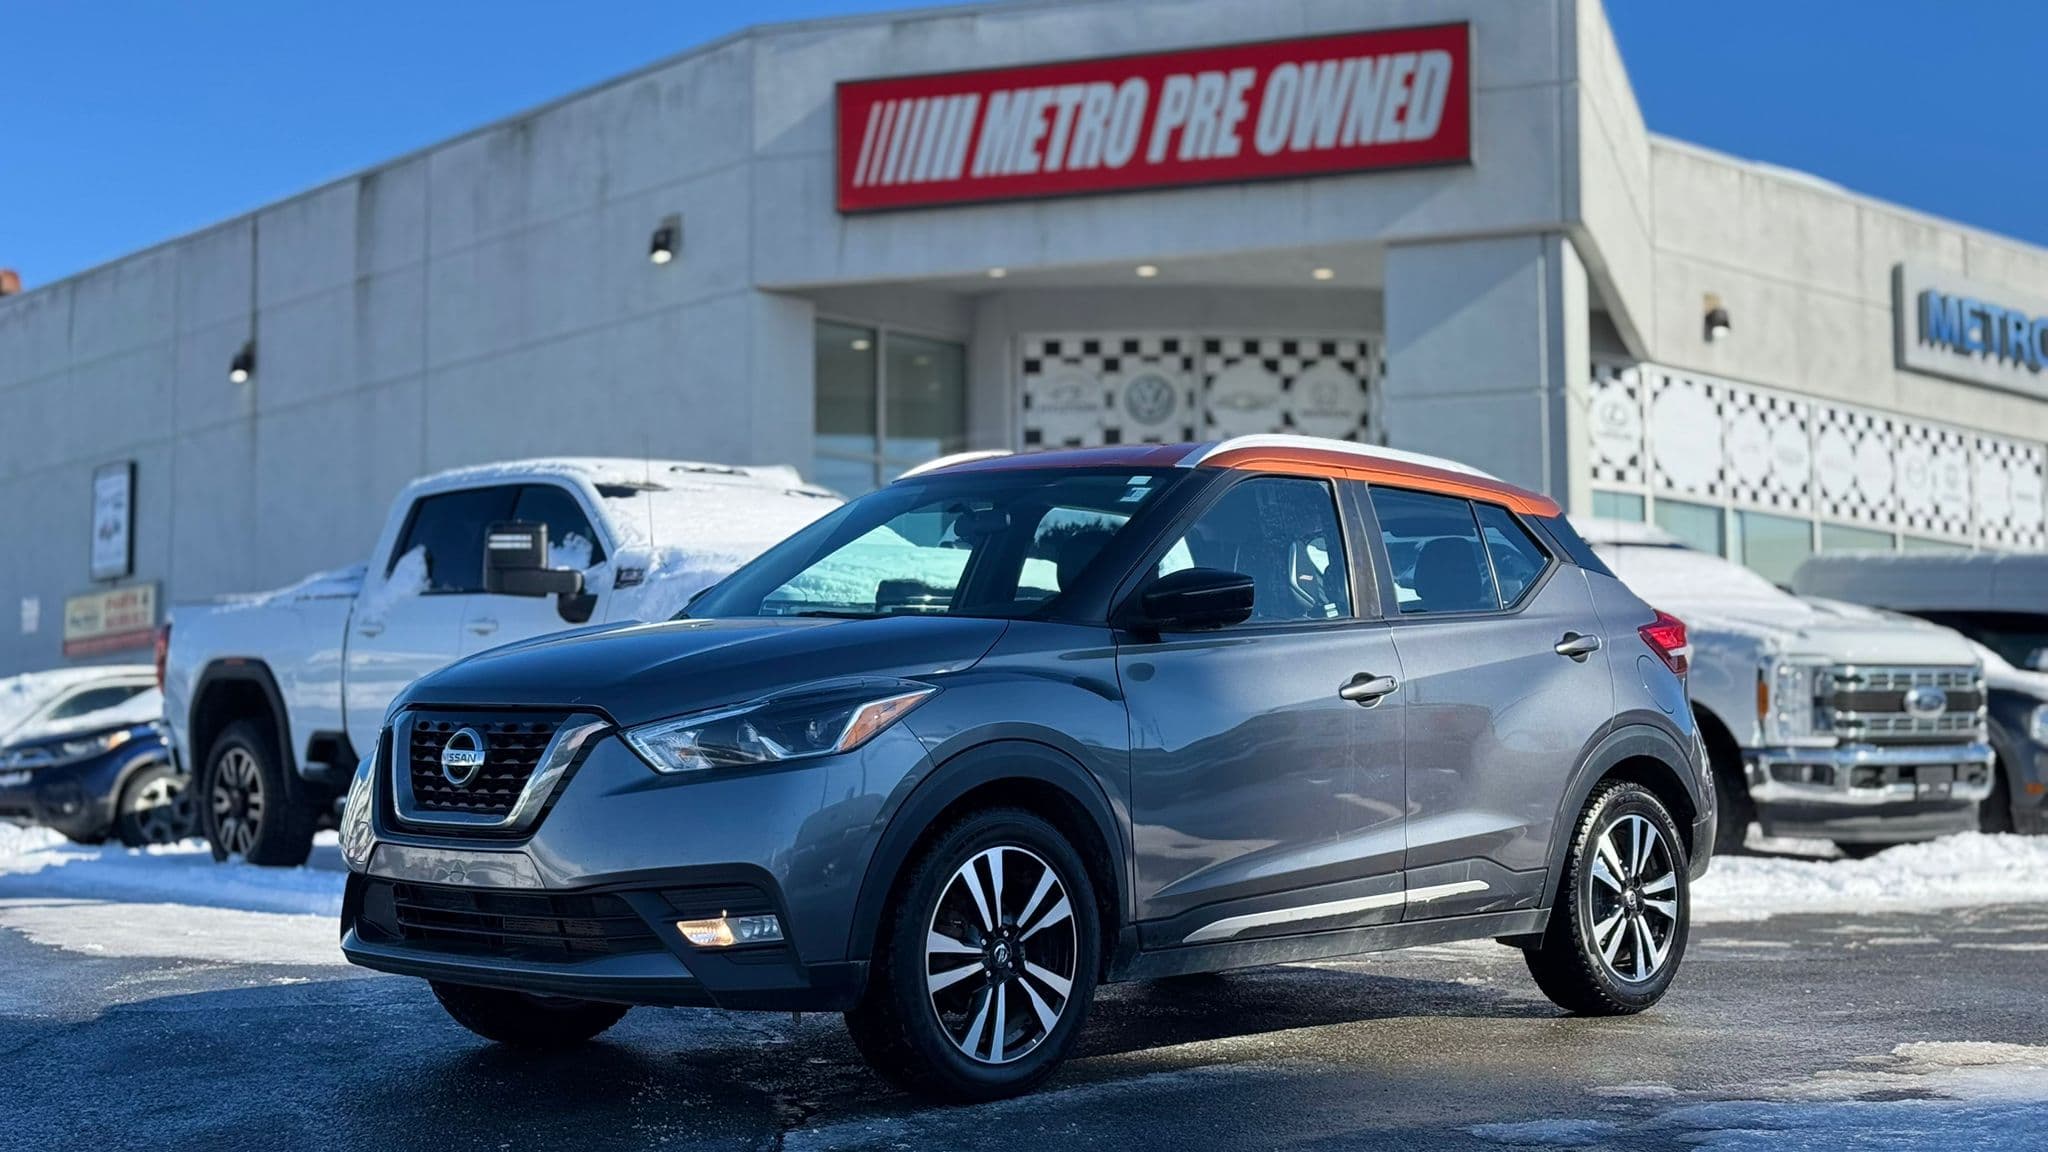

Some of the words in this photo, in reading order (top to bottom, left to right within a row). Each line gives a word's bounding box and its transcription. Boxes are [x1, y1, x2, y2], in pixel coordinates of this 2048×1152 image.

[972, 77, 1149, 178] METRO
[1146, 67, 1257, 164] PRE
[1254, 49, 1453, 156] OWNED
